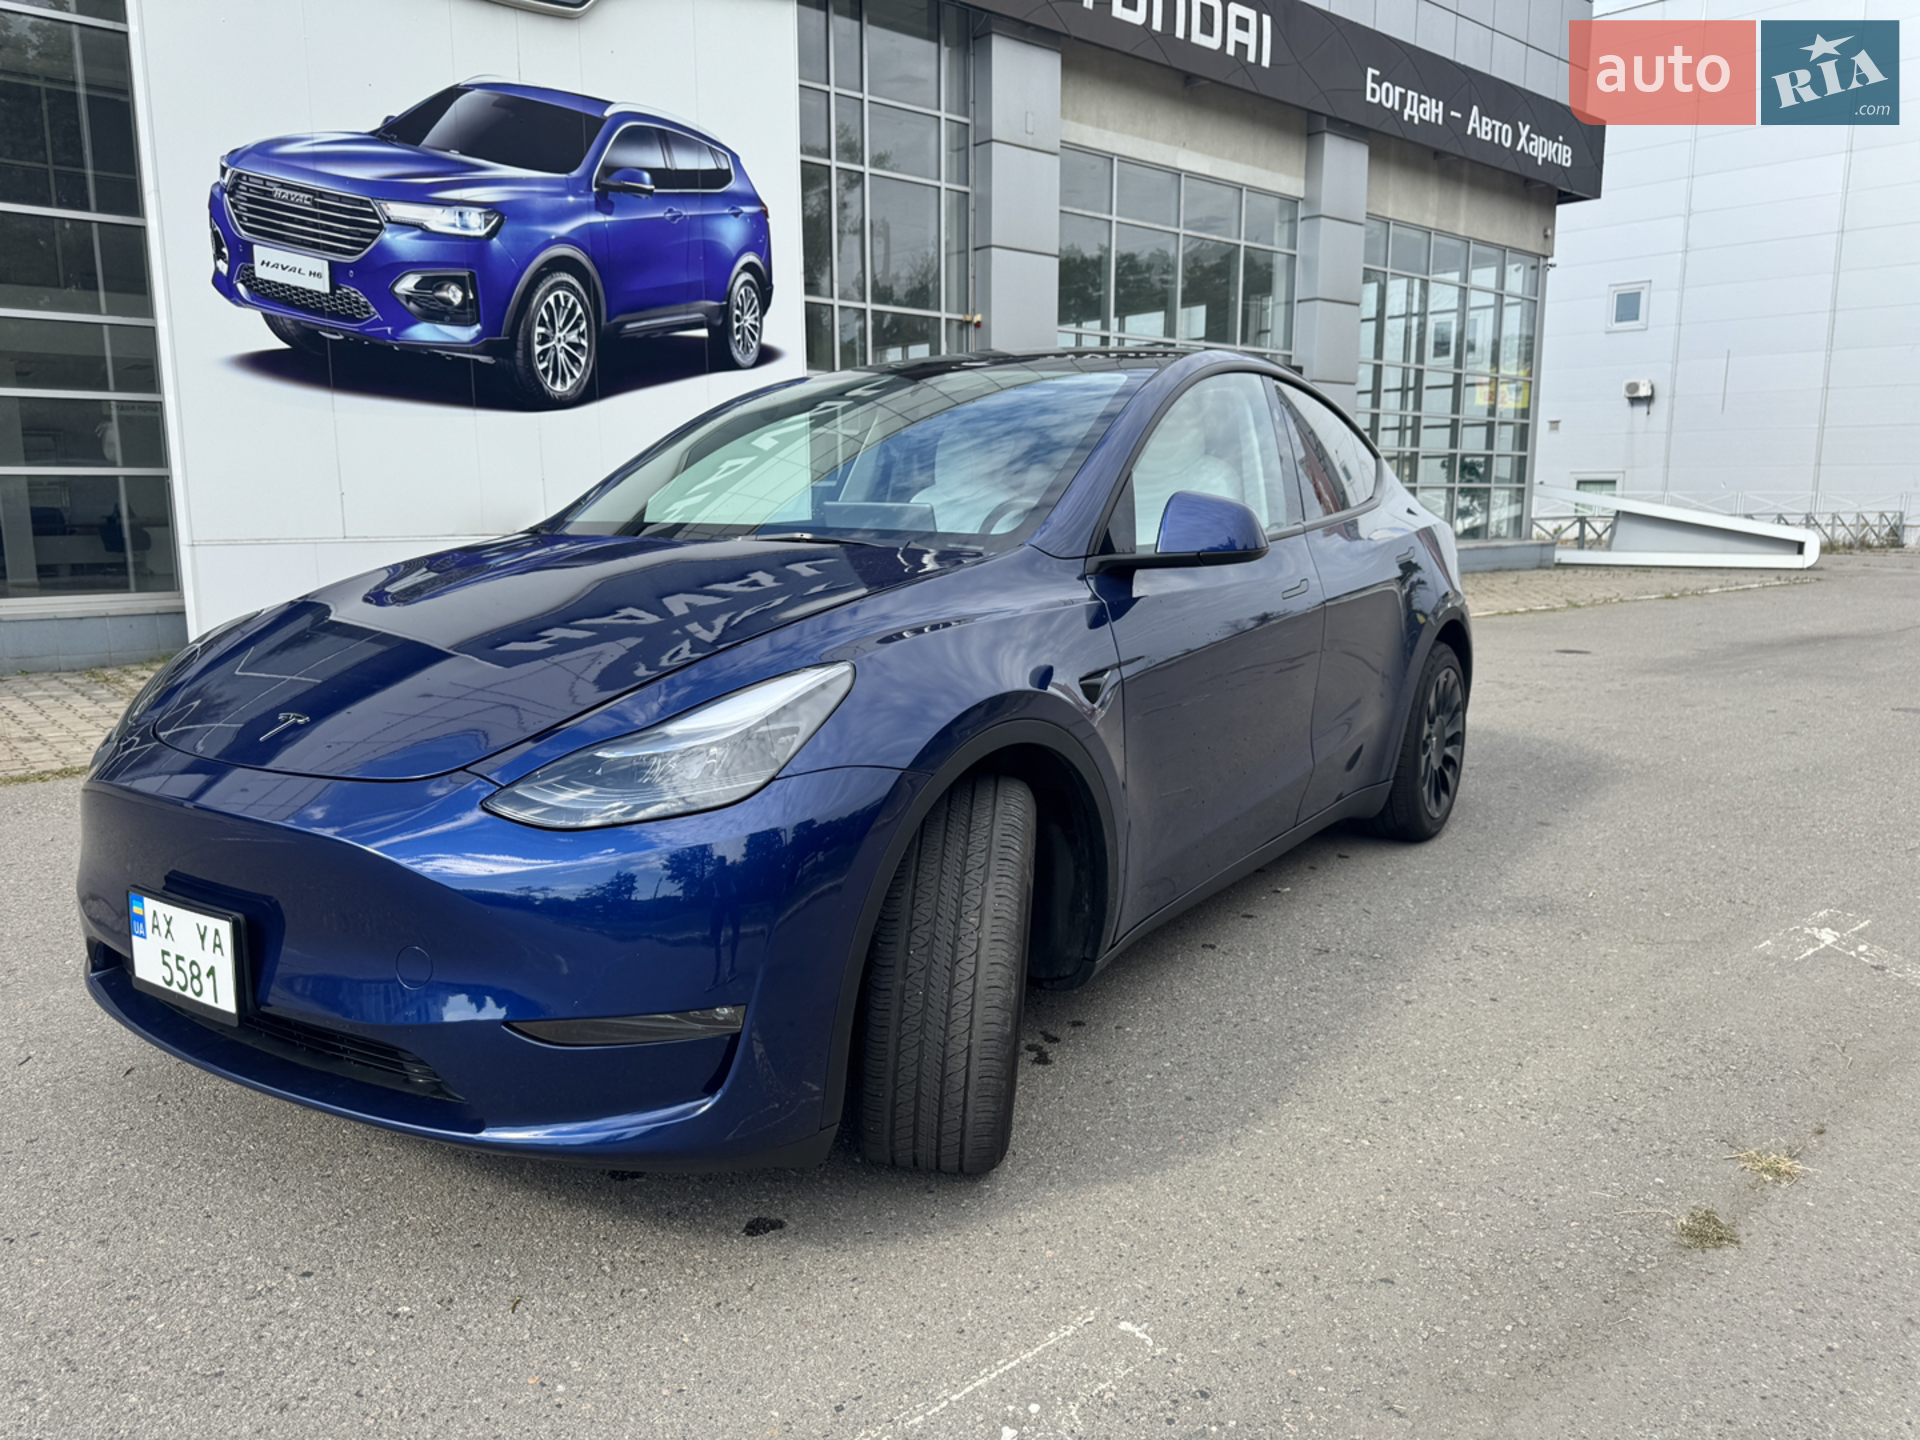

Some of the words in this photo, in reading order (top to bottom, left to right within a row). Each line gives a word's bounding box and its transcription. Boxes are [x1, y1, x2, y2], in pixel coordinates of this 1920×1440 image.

[1365, 66, 1444, 125] Богдан
[1466, 104, 1513, 149] Авто
[1516, 120, 1573, 168] Харків
[260, 259, 306, 276] HAVAL
[308, 269, 323, 280] H6
[133, 921, 145, 937] UA
[151, 909, 175, 943] AX
[195, 922, 225, 957] YA
[160, 948, 218, 1005] 5581
